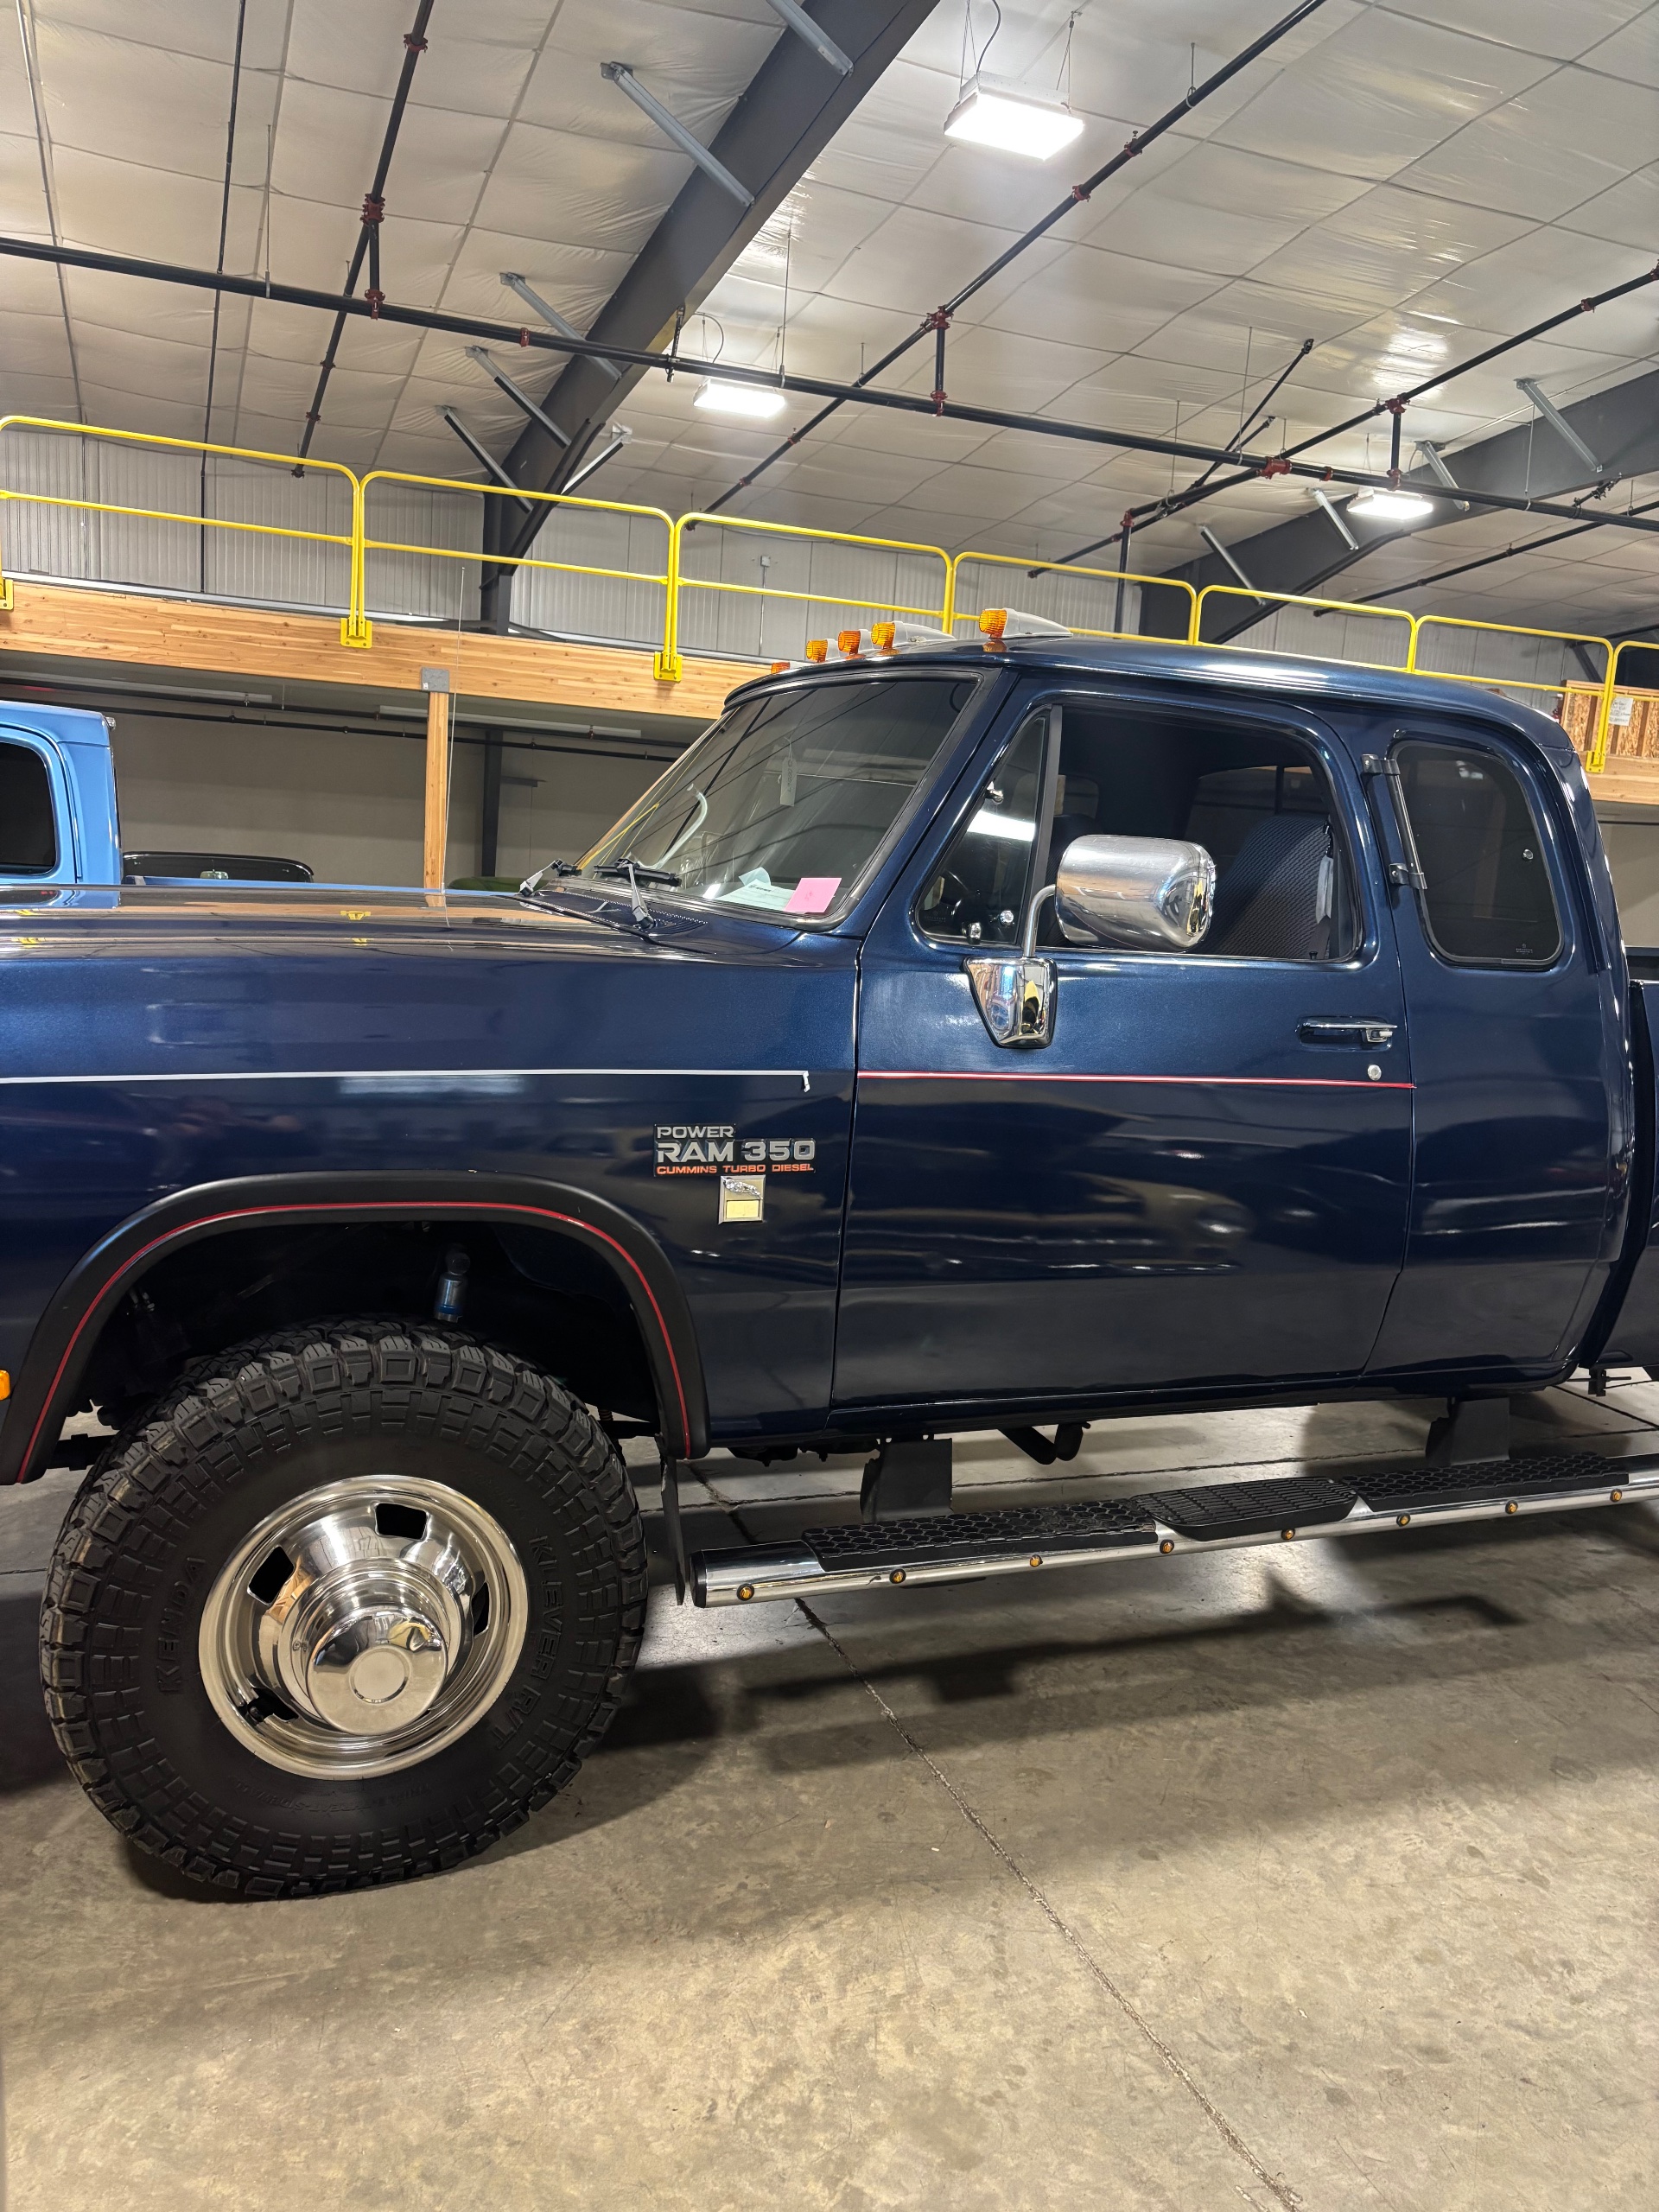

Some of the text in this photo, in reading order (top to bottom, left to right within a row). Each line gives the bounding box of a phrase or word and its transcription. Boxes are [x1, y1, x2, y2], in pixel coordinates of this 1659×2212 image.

[657, 1125, 734, 1139] POWER
[657, 1139, 816, 1163] RAM 350
[656, 1163, 814, 1174] CUMMINS TURBO DIESEL
[156, 1556, 207, 1695] KENDA
[491, 1535, 565, 1750] KLEVER R/T
